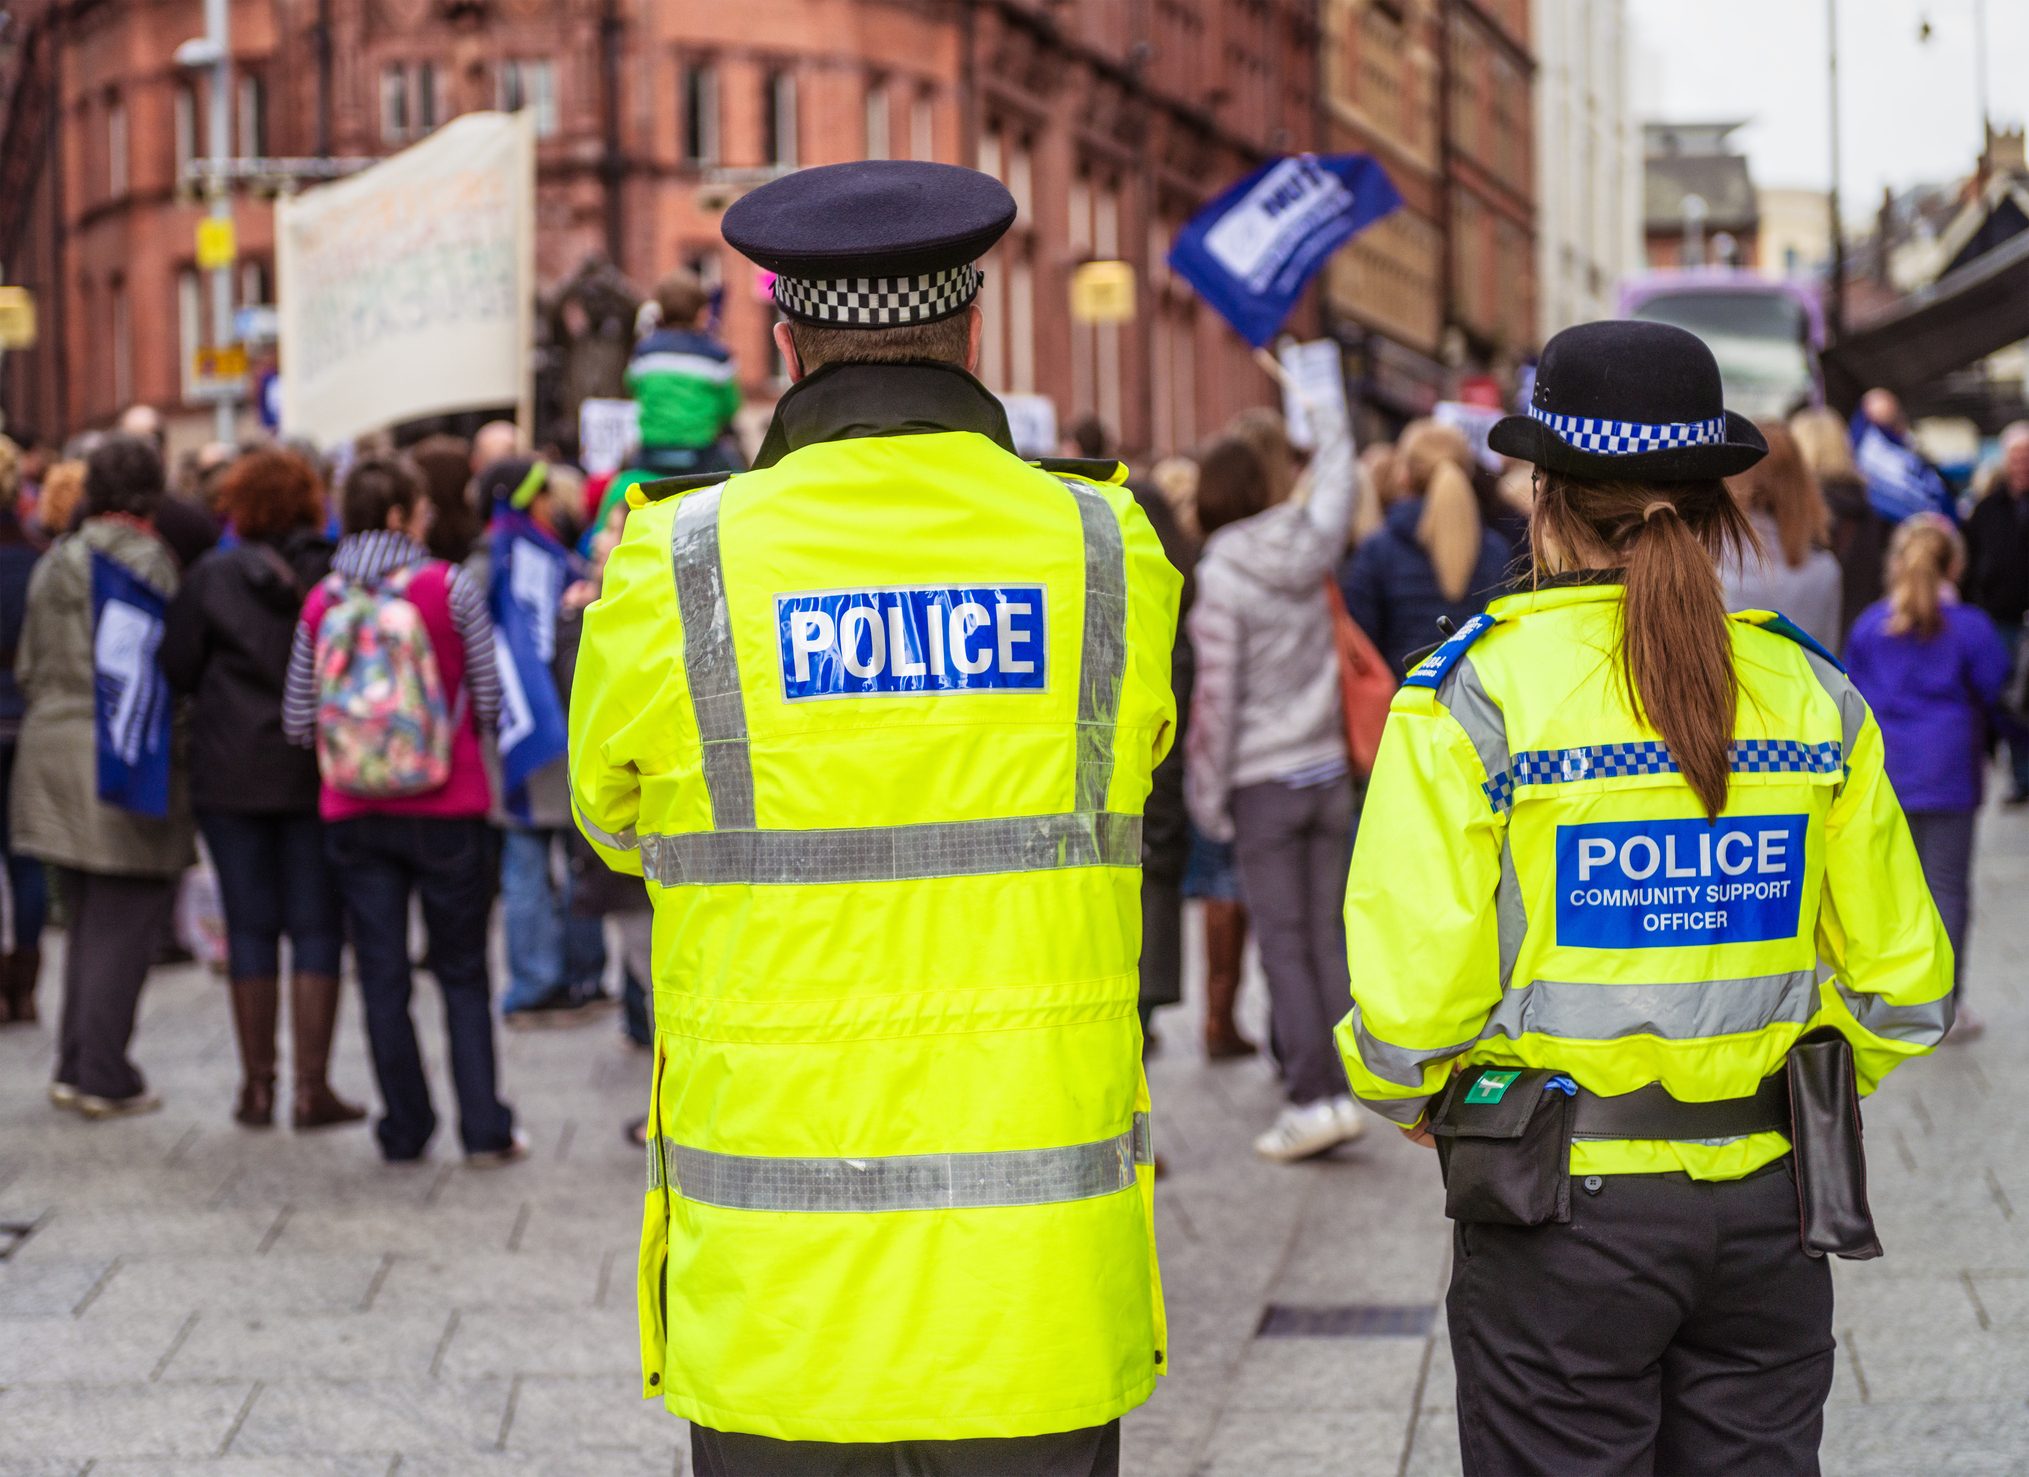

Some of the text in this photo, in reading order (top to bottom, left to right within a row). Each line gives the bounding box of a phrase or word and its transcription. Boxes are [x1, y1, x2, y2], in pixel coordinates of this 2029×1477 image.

[790, 602, 1034, 683] POLICE
[1578, 829, 1789, 881] POLICE
[1570, 880, 1791, 907] COMMUNITY SUPPORT
[1643, 910, 1727, 931] OFFICER
